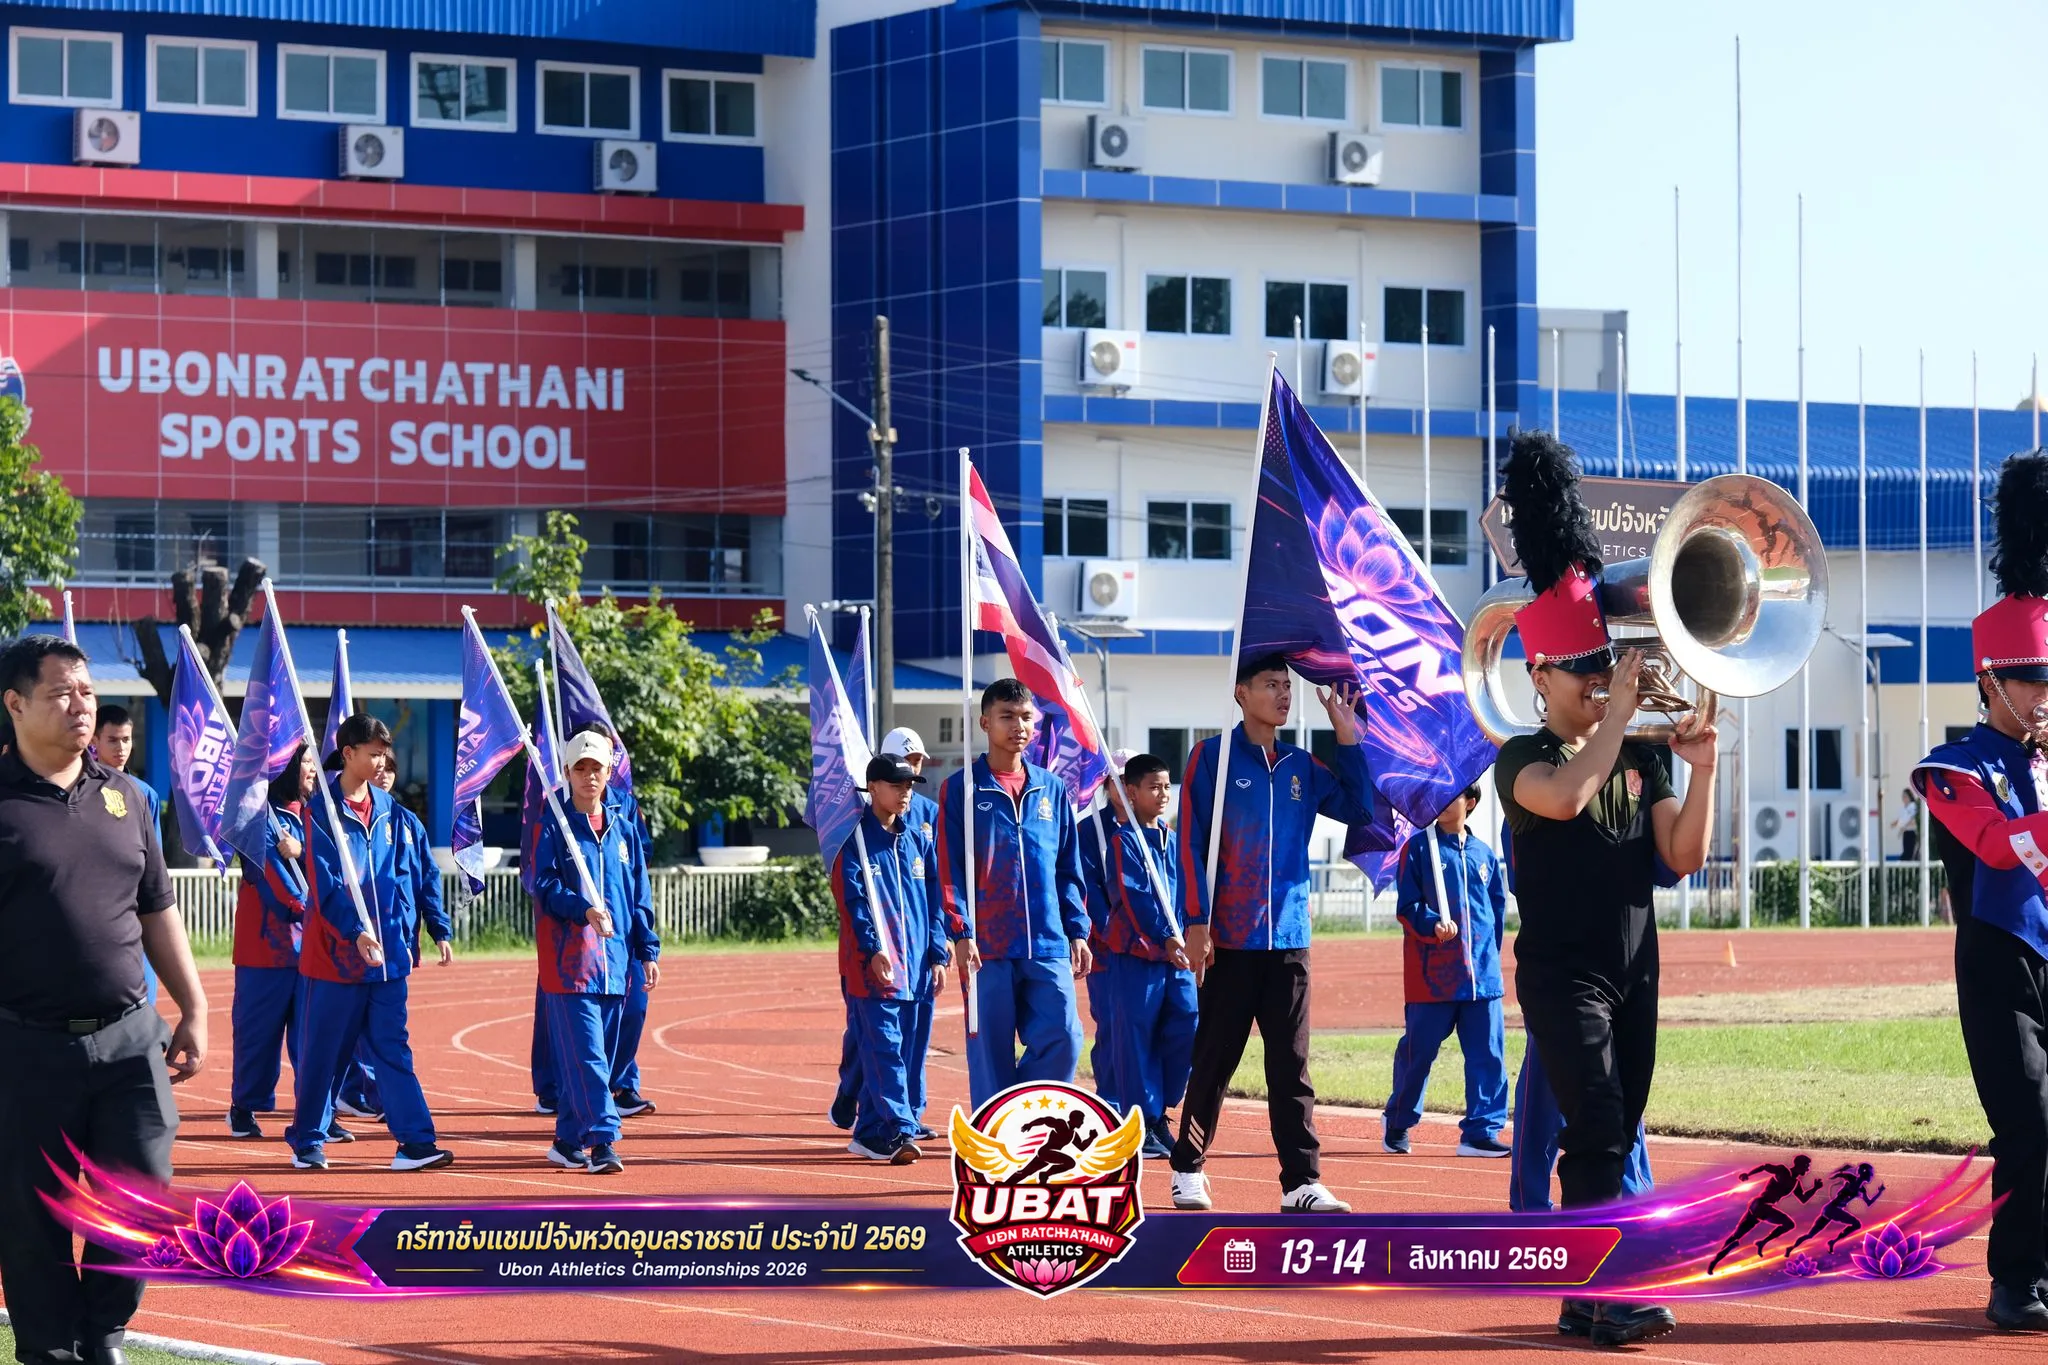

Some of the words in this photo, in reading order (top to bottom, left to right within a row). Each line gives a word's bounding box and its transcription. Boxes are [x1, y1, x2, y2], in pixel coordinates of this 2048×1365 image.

[98, 346, 624, 411] UBONRATCHATHANI
[160, 412, 361, 464] SPORTS
[390, 420, 586, 470] SCHOOL
